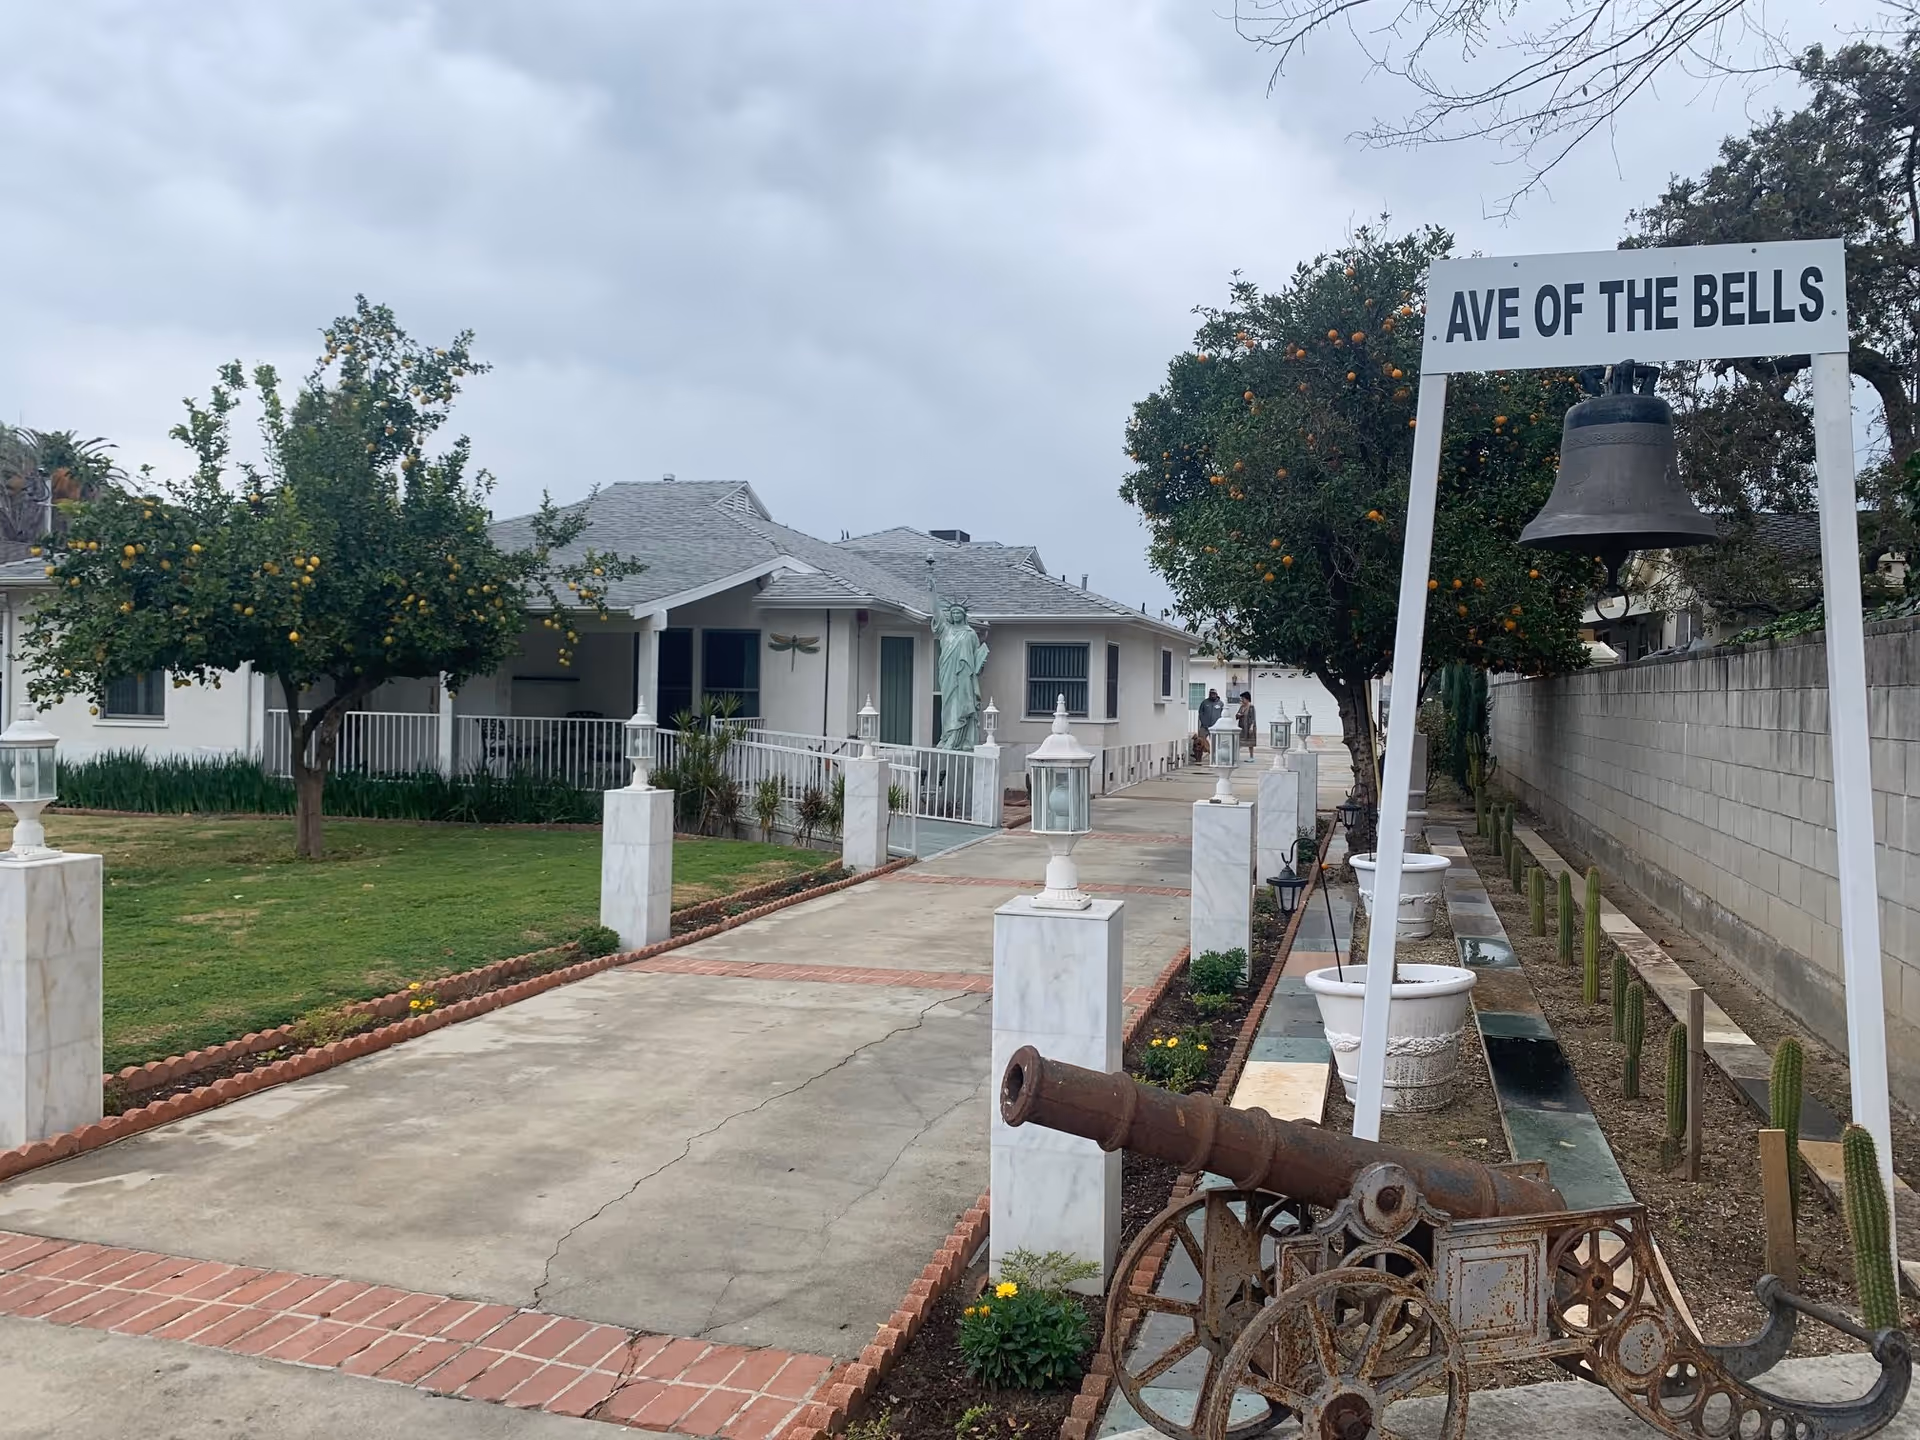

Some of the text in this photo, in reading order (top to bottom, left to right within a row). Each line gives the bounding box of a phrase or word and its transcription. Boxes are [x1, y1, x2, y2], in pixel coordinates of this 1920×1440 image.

[1445, 266, 1824, 343] AVE OF THE BELLS
